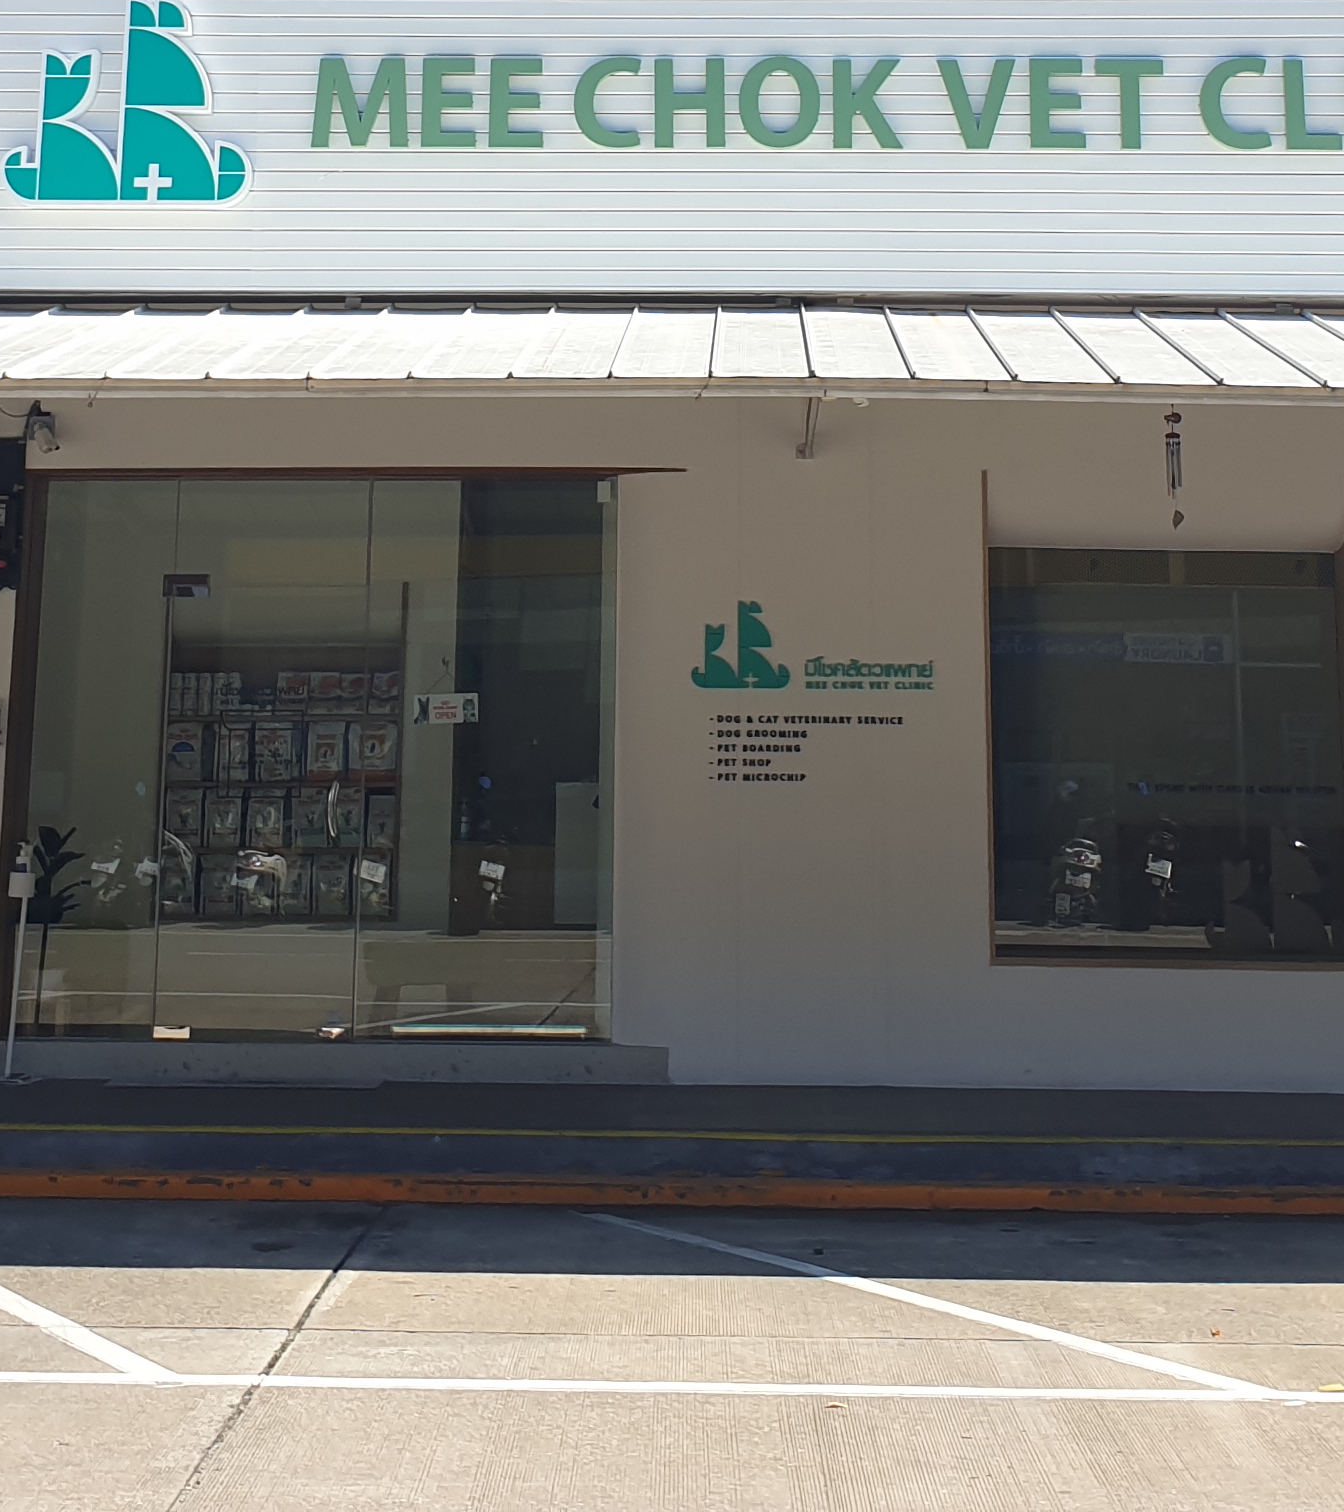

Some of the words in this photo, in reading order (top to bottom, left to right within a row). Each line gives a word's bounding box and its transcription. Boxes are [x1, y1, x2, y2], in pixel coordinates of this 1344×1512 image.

[310, 55, 545, 149] MEE
[573, 55, 903, 151] CHOK
[937, 57, 1164, 152] VET
